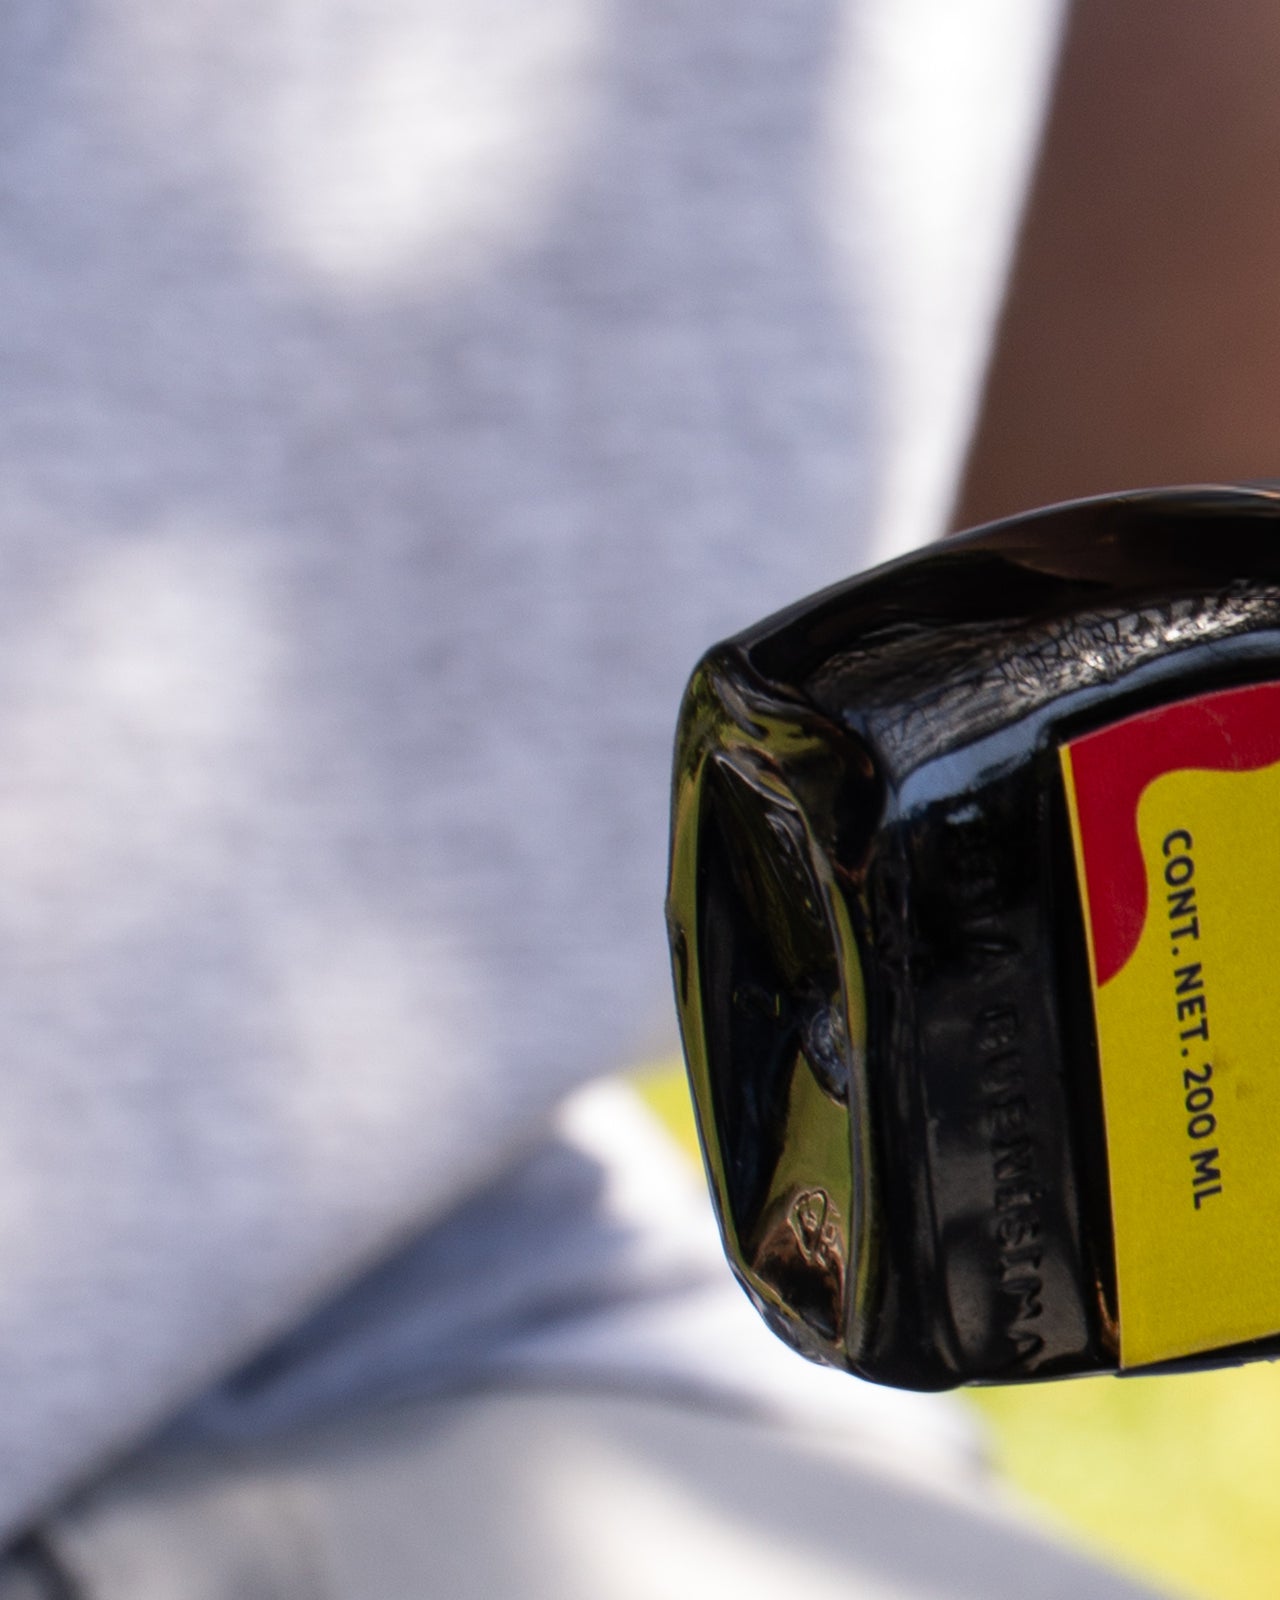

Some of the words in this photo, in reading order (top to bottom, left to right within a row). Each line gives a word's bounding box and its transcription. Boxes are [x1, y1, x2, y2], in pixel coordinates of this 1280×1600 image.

[1162, 828, 1200, 957] CONT.
[1174, 963, 1209, 1058] NET.
[1183, 1063, 1216, 1141] 200
[1190, 1148, 1222, 1211] ML
